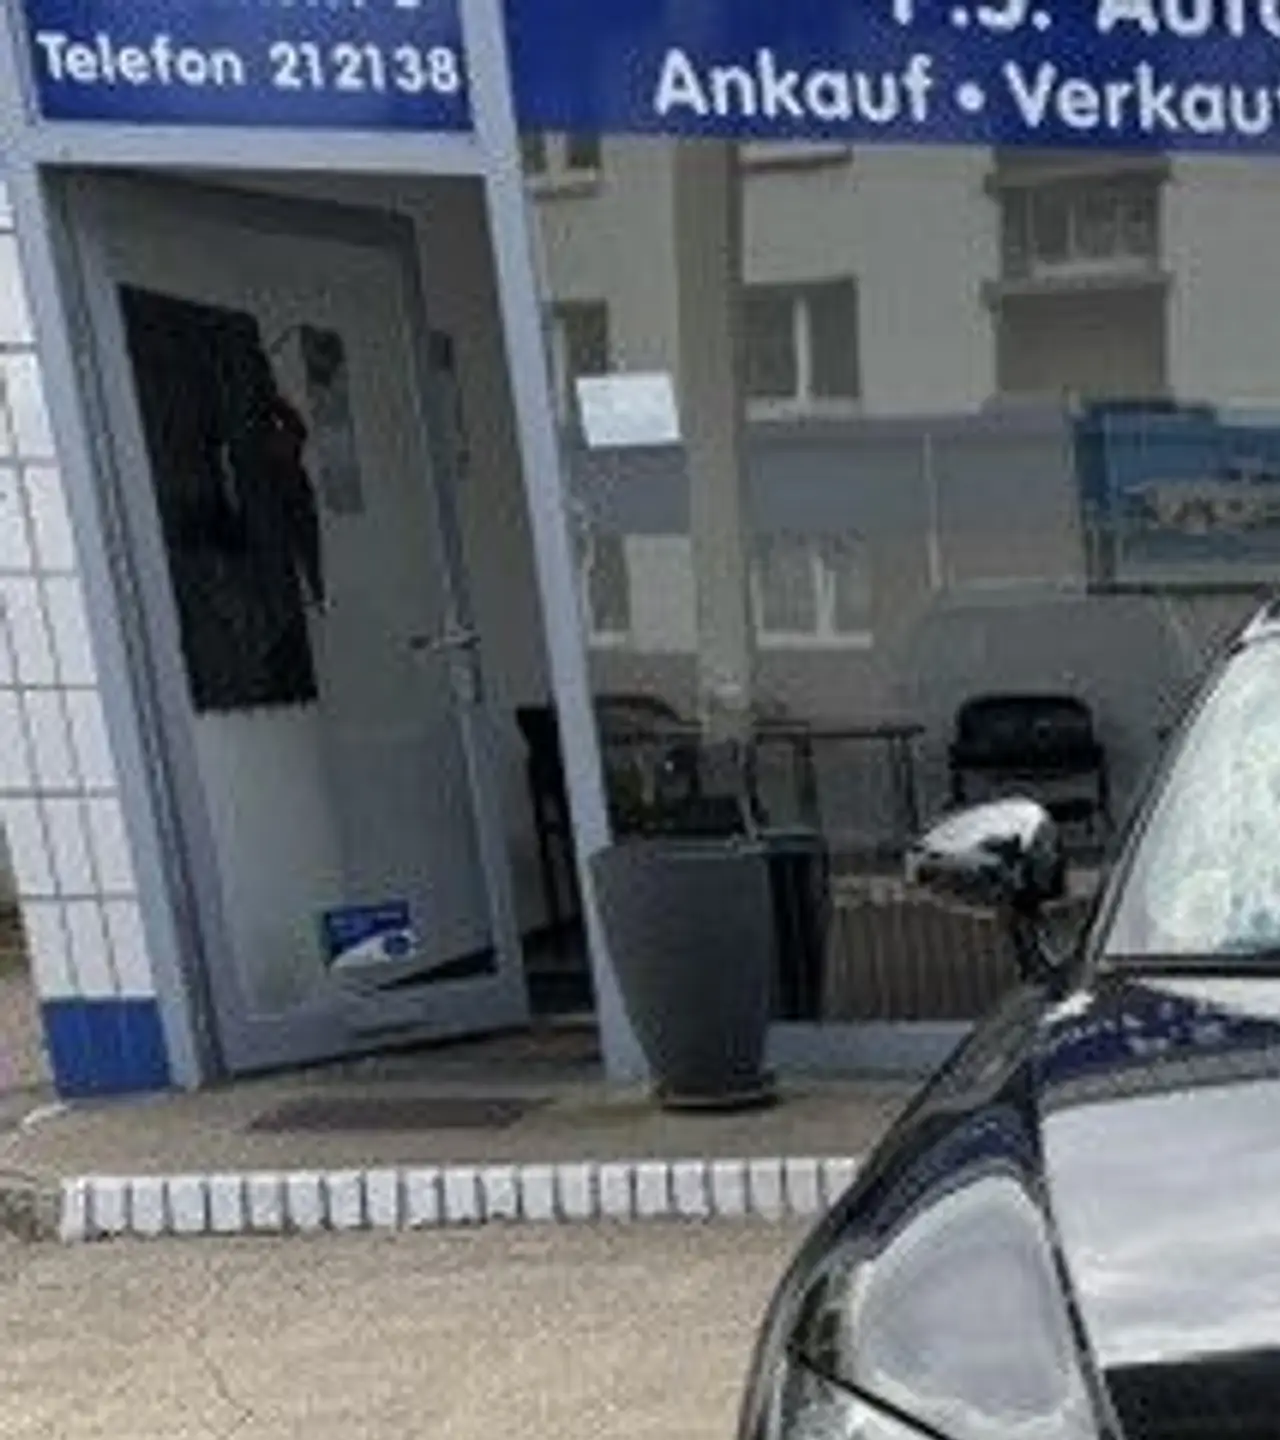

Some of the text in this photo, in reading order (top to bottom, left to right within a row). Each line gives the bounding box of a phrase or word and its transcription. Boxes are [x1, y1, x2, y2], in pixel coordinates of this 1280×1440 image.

[36, 32, 459, 93] Telefon 212138
[654, 47, 932, 122] Ankauf
